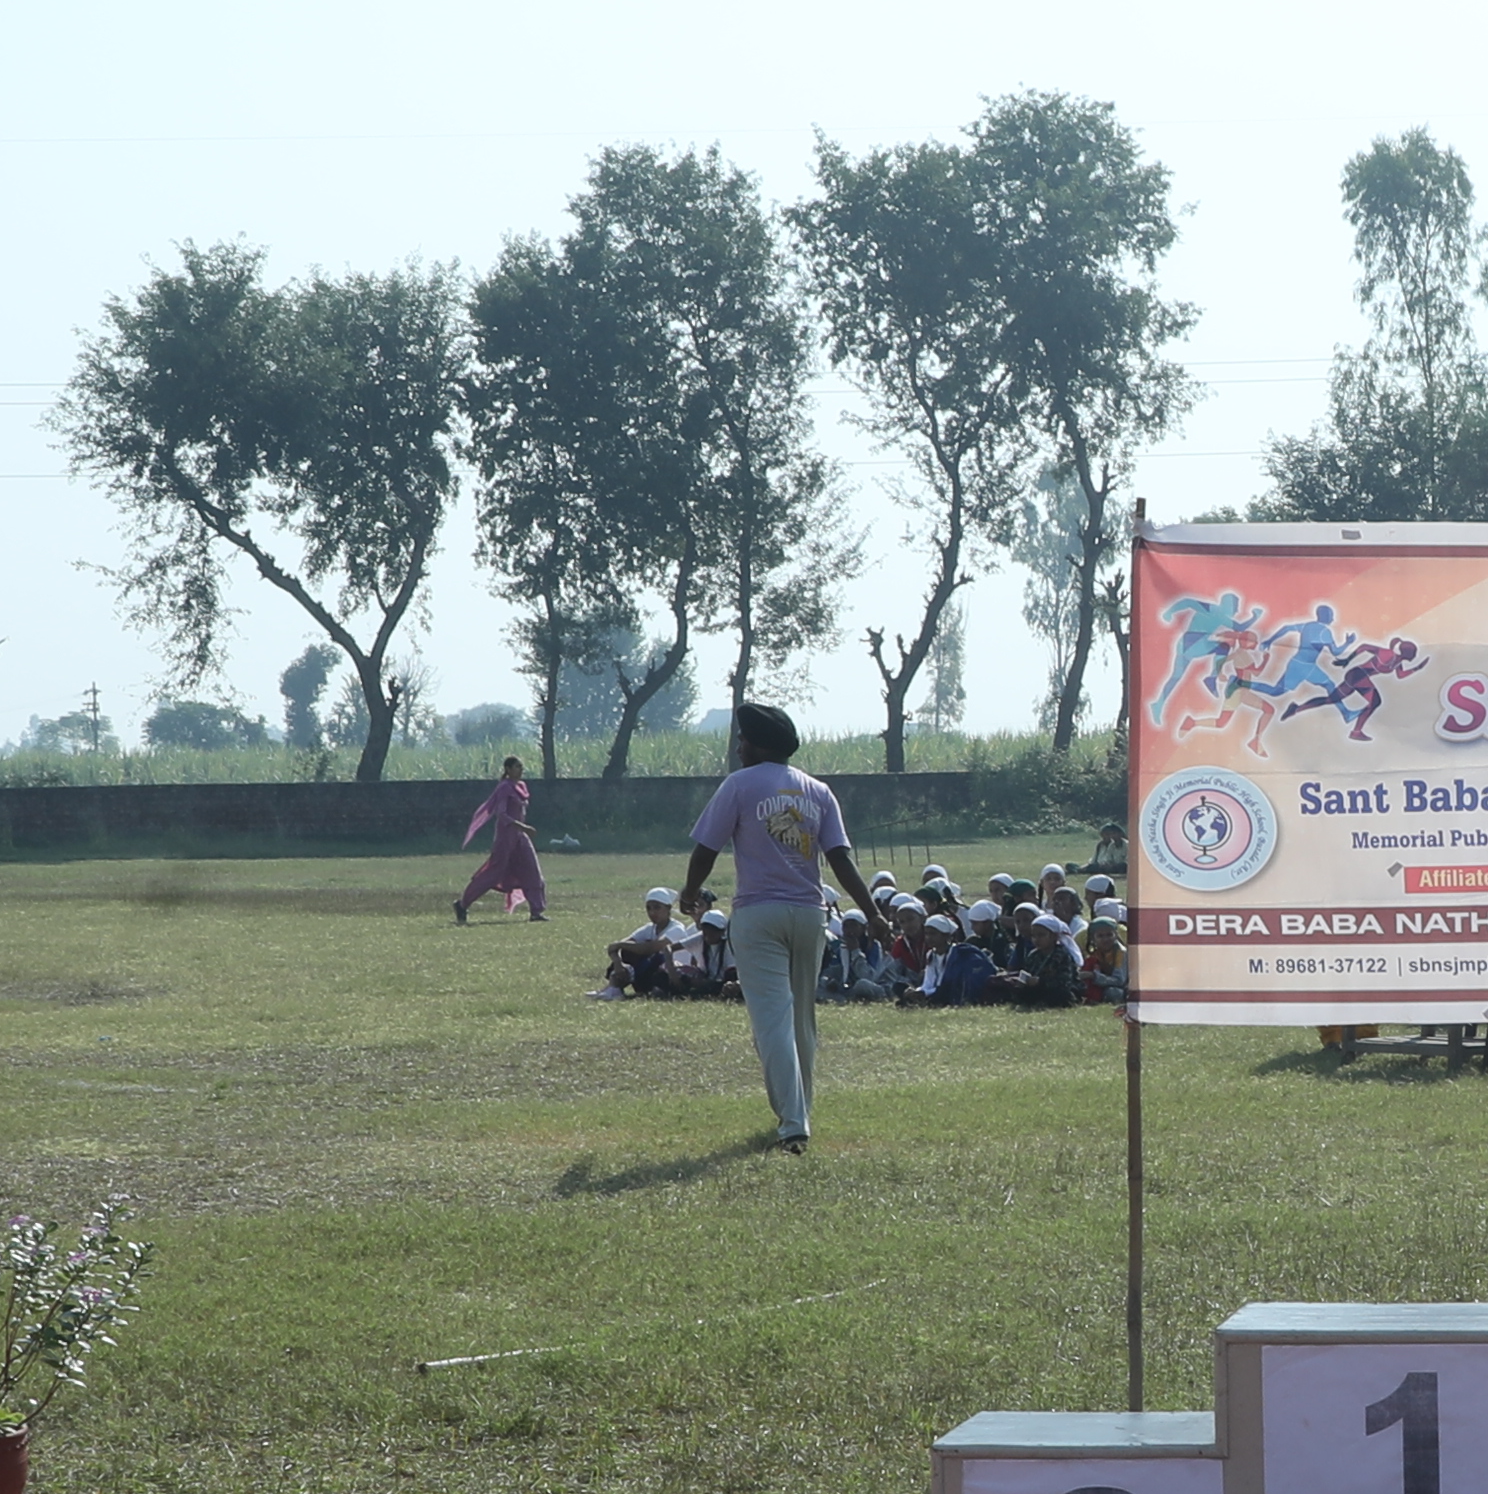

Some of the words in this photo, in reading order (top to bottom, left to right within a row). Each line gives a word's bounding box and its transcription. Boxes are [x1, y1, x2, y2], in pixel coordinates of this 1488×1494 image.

[1300, 782, 1390, 814] Sant
[1352, 830, 1445, 849] Memorial
[1168, 913, 1271, 936] DERA
[1280, 912, 1385, 935] BABA
[1249, 958, 1271, 974] M:
[1275, 957, 1388, 974] 89681-37122
